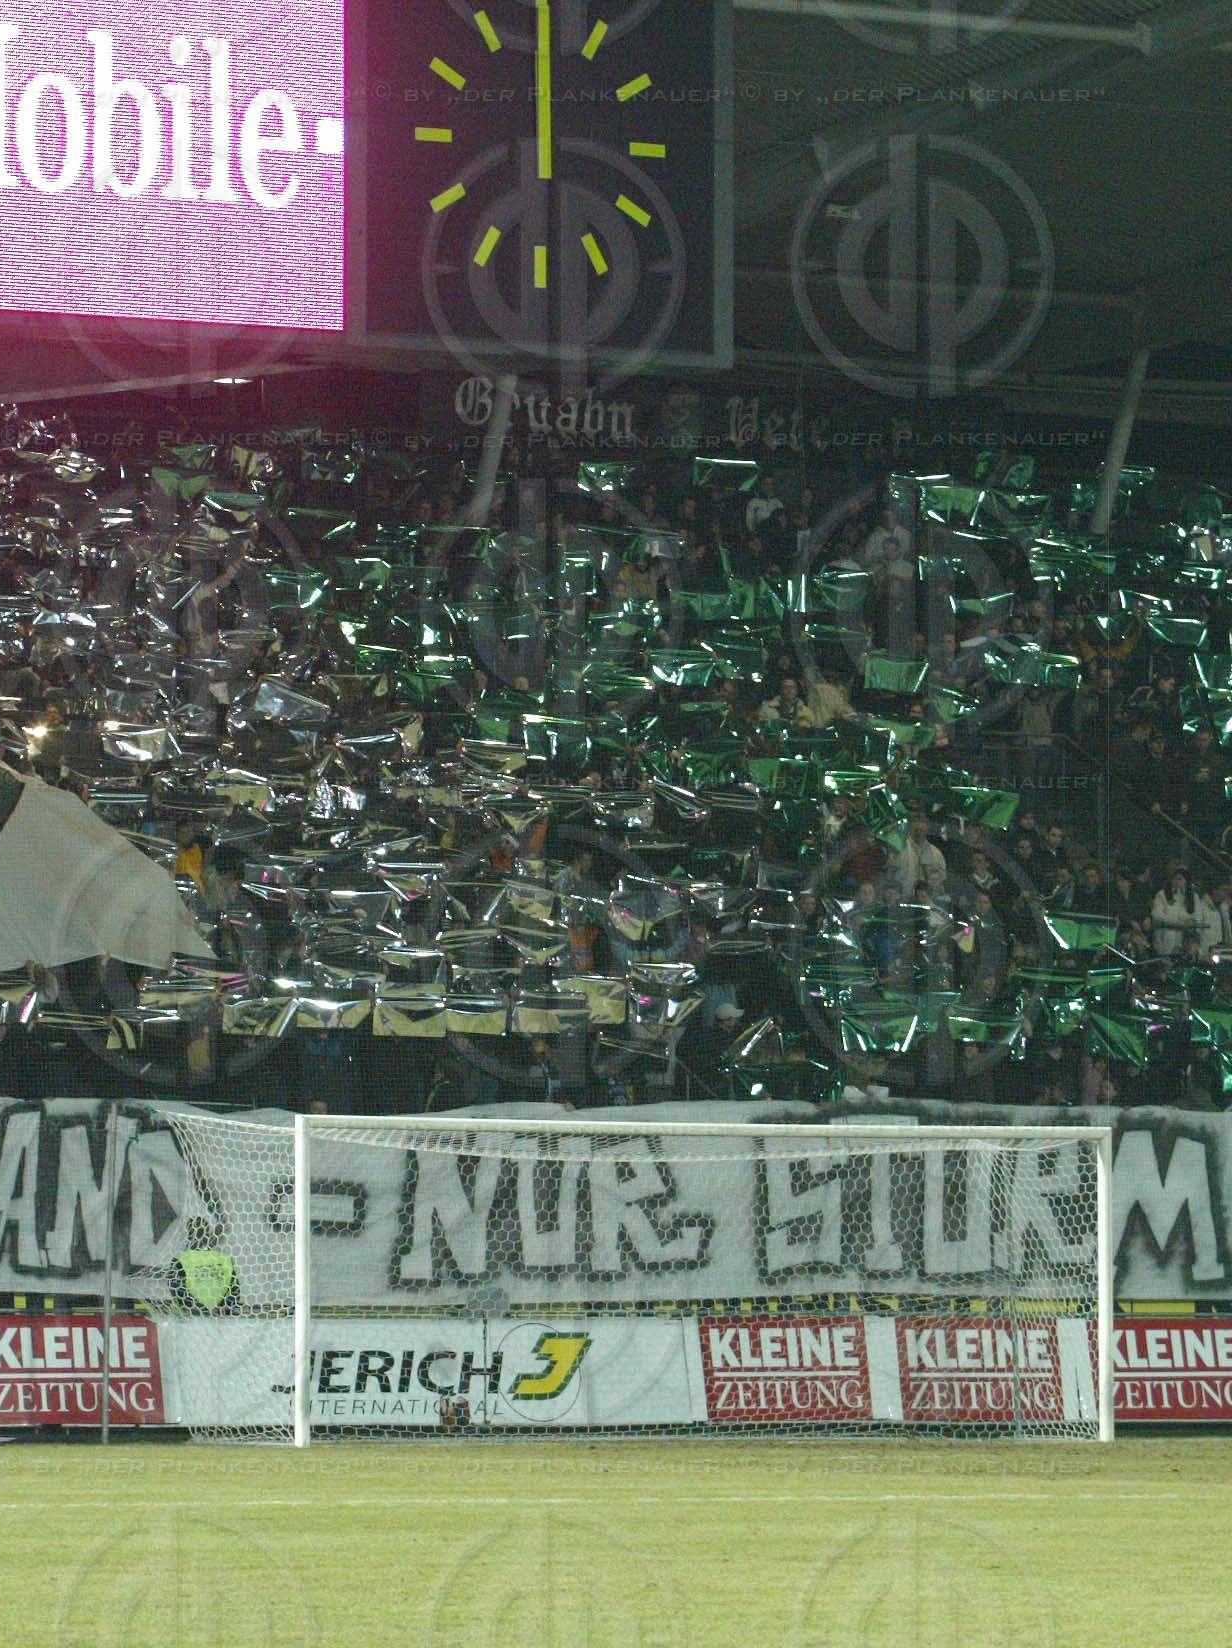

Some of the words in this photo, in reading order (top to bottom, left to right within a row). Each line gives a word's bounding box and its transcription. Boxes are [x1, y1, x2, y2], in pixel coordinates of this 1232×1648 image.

[389, 1133, 715, 1289] NUR
[754, 1102, 1230, 1286] STURM
[710, 1327, 860, 1368] KLEINE
[906, 1328, 1052, 1369] KLEINE
[717, 1381, 865, 1410] ZEITUNG
[910, 1381, 1059, 1411] ZEITUNG
